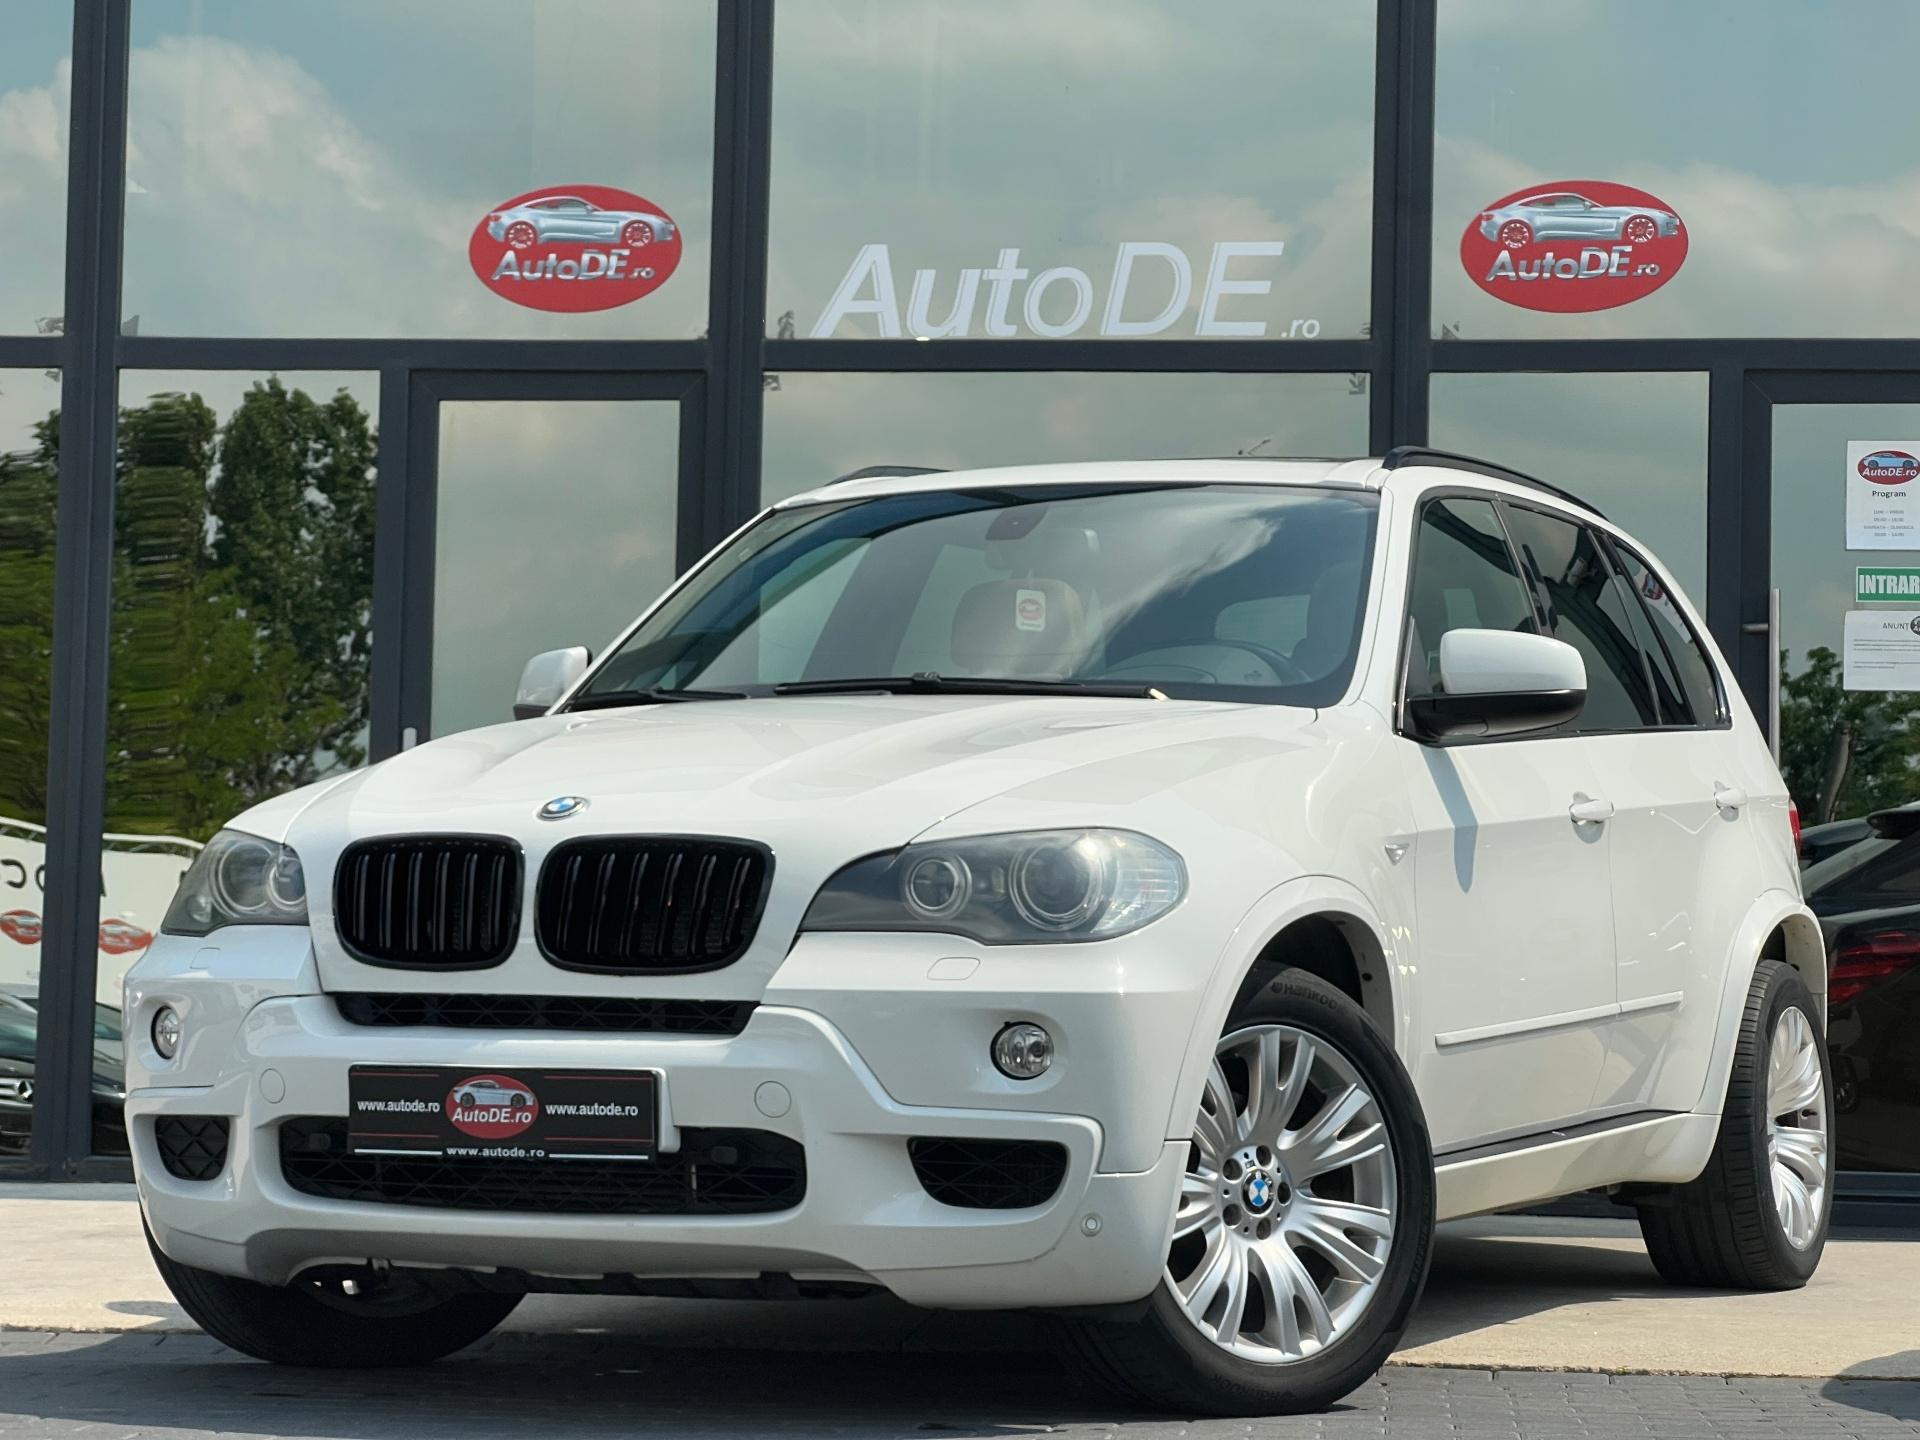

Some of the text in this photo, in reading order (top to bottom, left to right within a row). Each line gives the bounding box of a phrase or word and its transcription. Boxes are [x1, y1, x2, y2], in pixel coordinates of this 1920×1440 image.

[1862, 467, 1918, 477] AutoDE.ro
[1872, 490, 1907, 499] Program
[1859, 574, 1920, 594] INTRAR
[357, 1099, 440, 1112] www.autode.ro
[545, 1102, 639, 1116] www.autode.ro
[452, 1107, 532, 1123] AutoDE.ro
[446, 1147, 545, 1158] www.autode.ro
